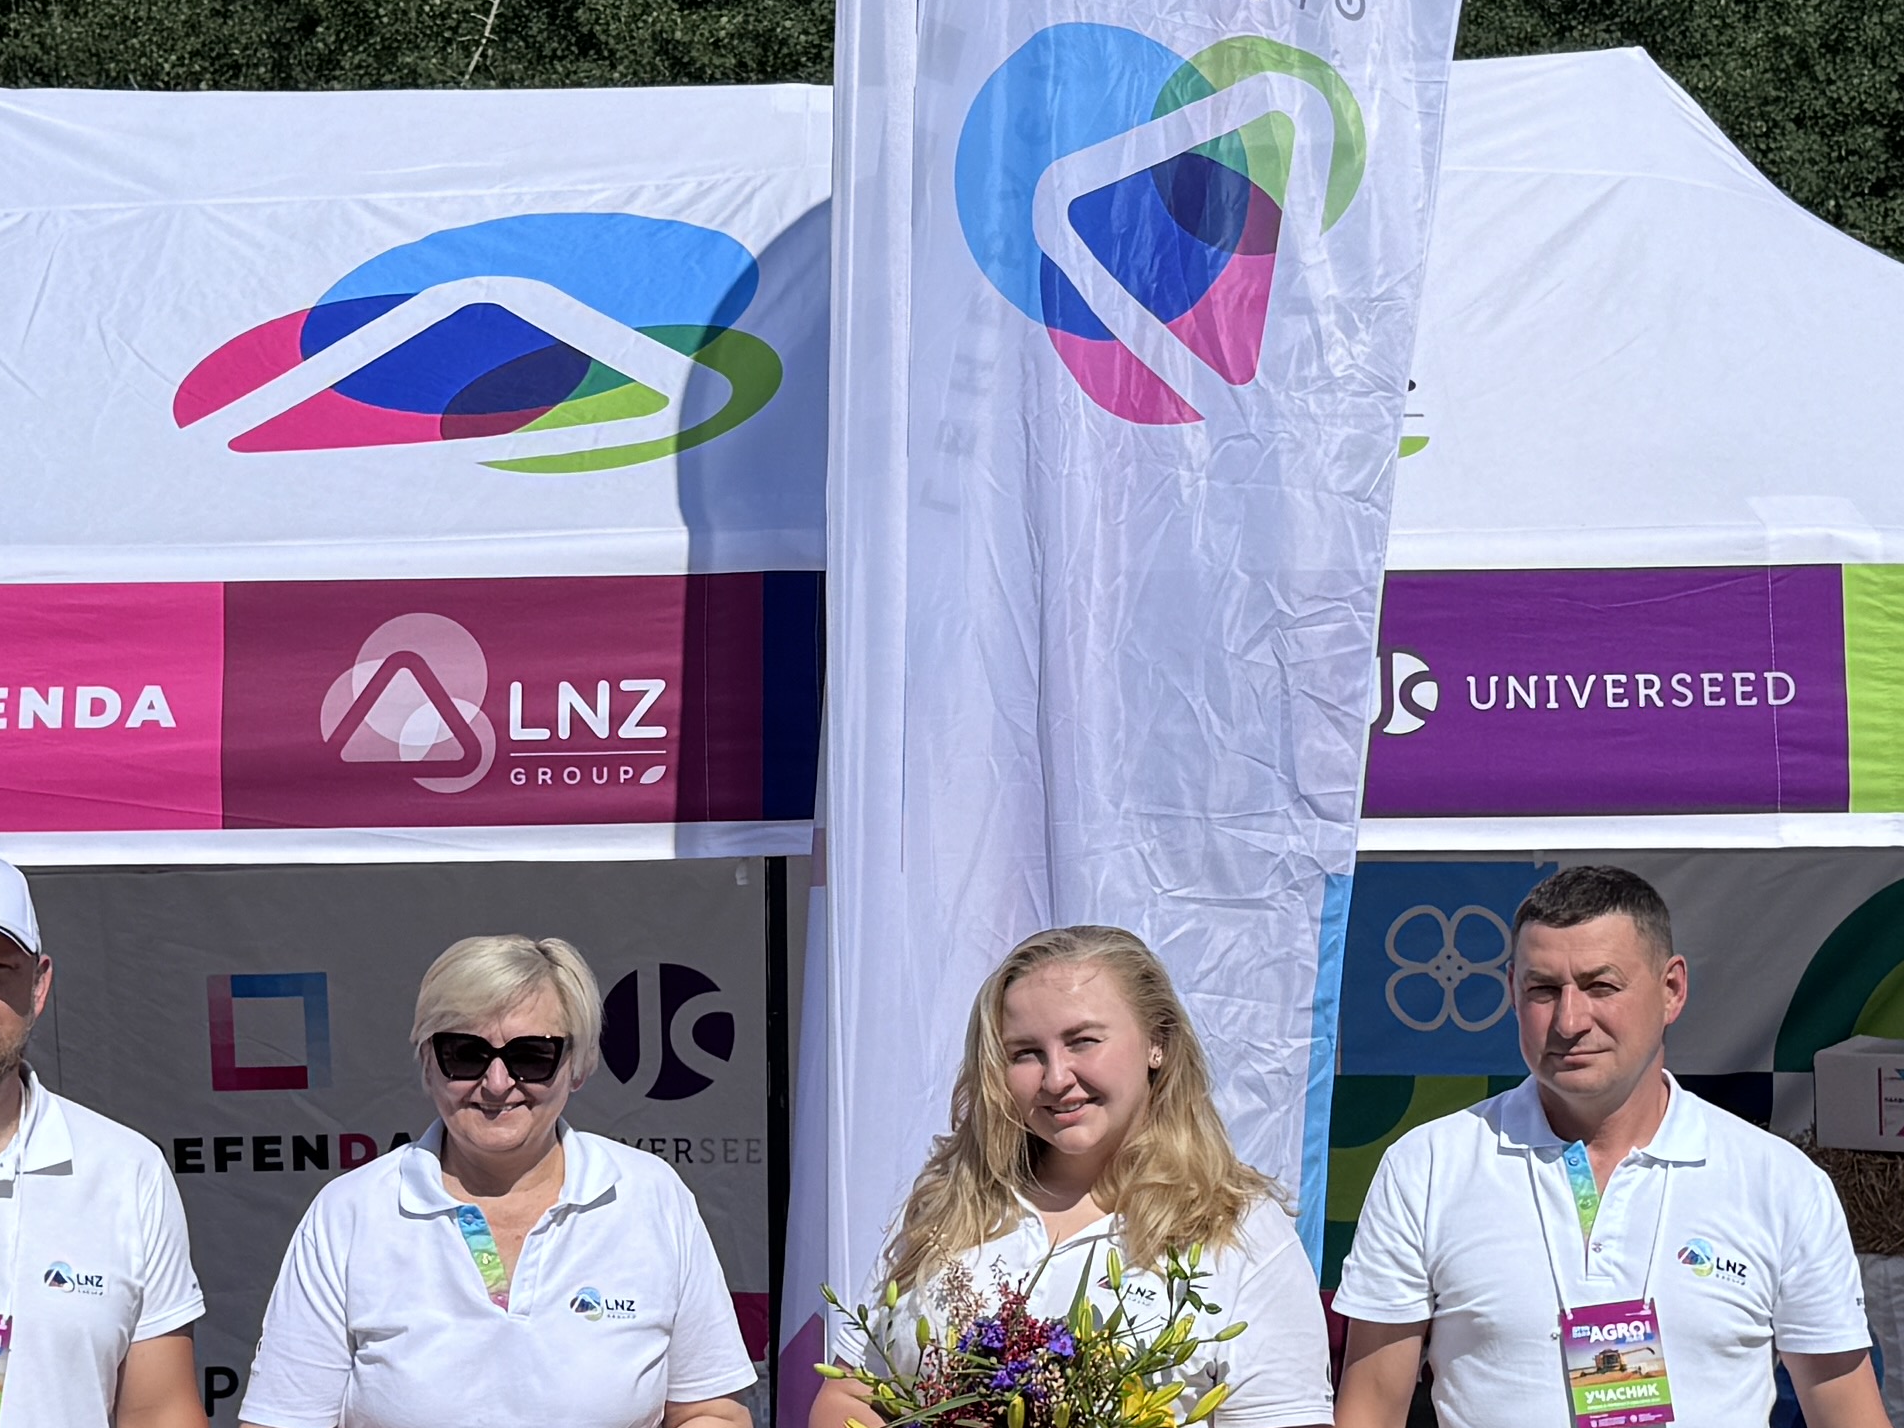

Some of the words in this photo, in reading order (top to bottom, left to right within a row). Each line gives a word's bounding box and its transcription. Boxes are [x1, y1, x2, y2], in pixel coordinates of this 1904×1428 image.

[1466, 670, 1797, 711] UNIVERSEED
[507, 678, 667, 741] LNZ
[508, 765, 638, 785] GROUP
[162, 1132, 412, 1174] EFEND
[620, 1138, 763, 1166] ERSEE
[1715, 1256, 1748, 1278] LNZ
[76, 1273, 104, 1288] LNZ
[1125, 1283, 1157, 1301] LNZ
[604, 1298, 636, 1312] LNZ
[1584, 1383, 1661, 1405] УЧАСНИК
